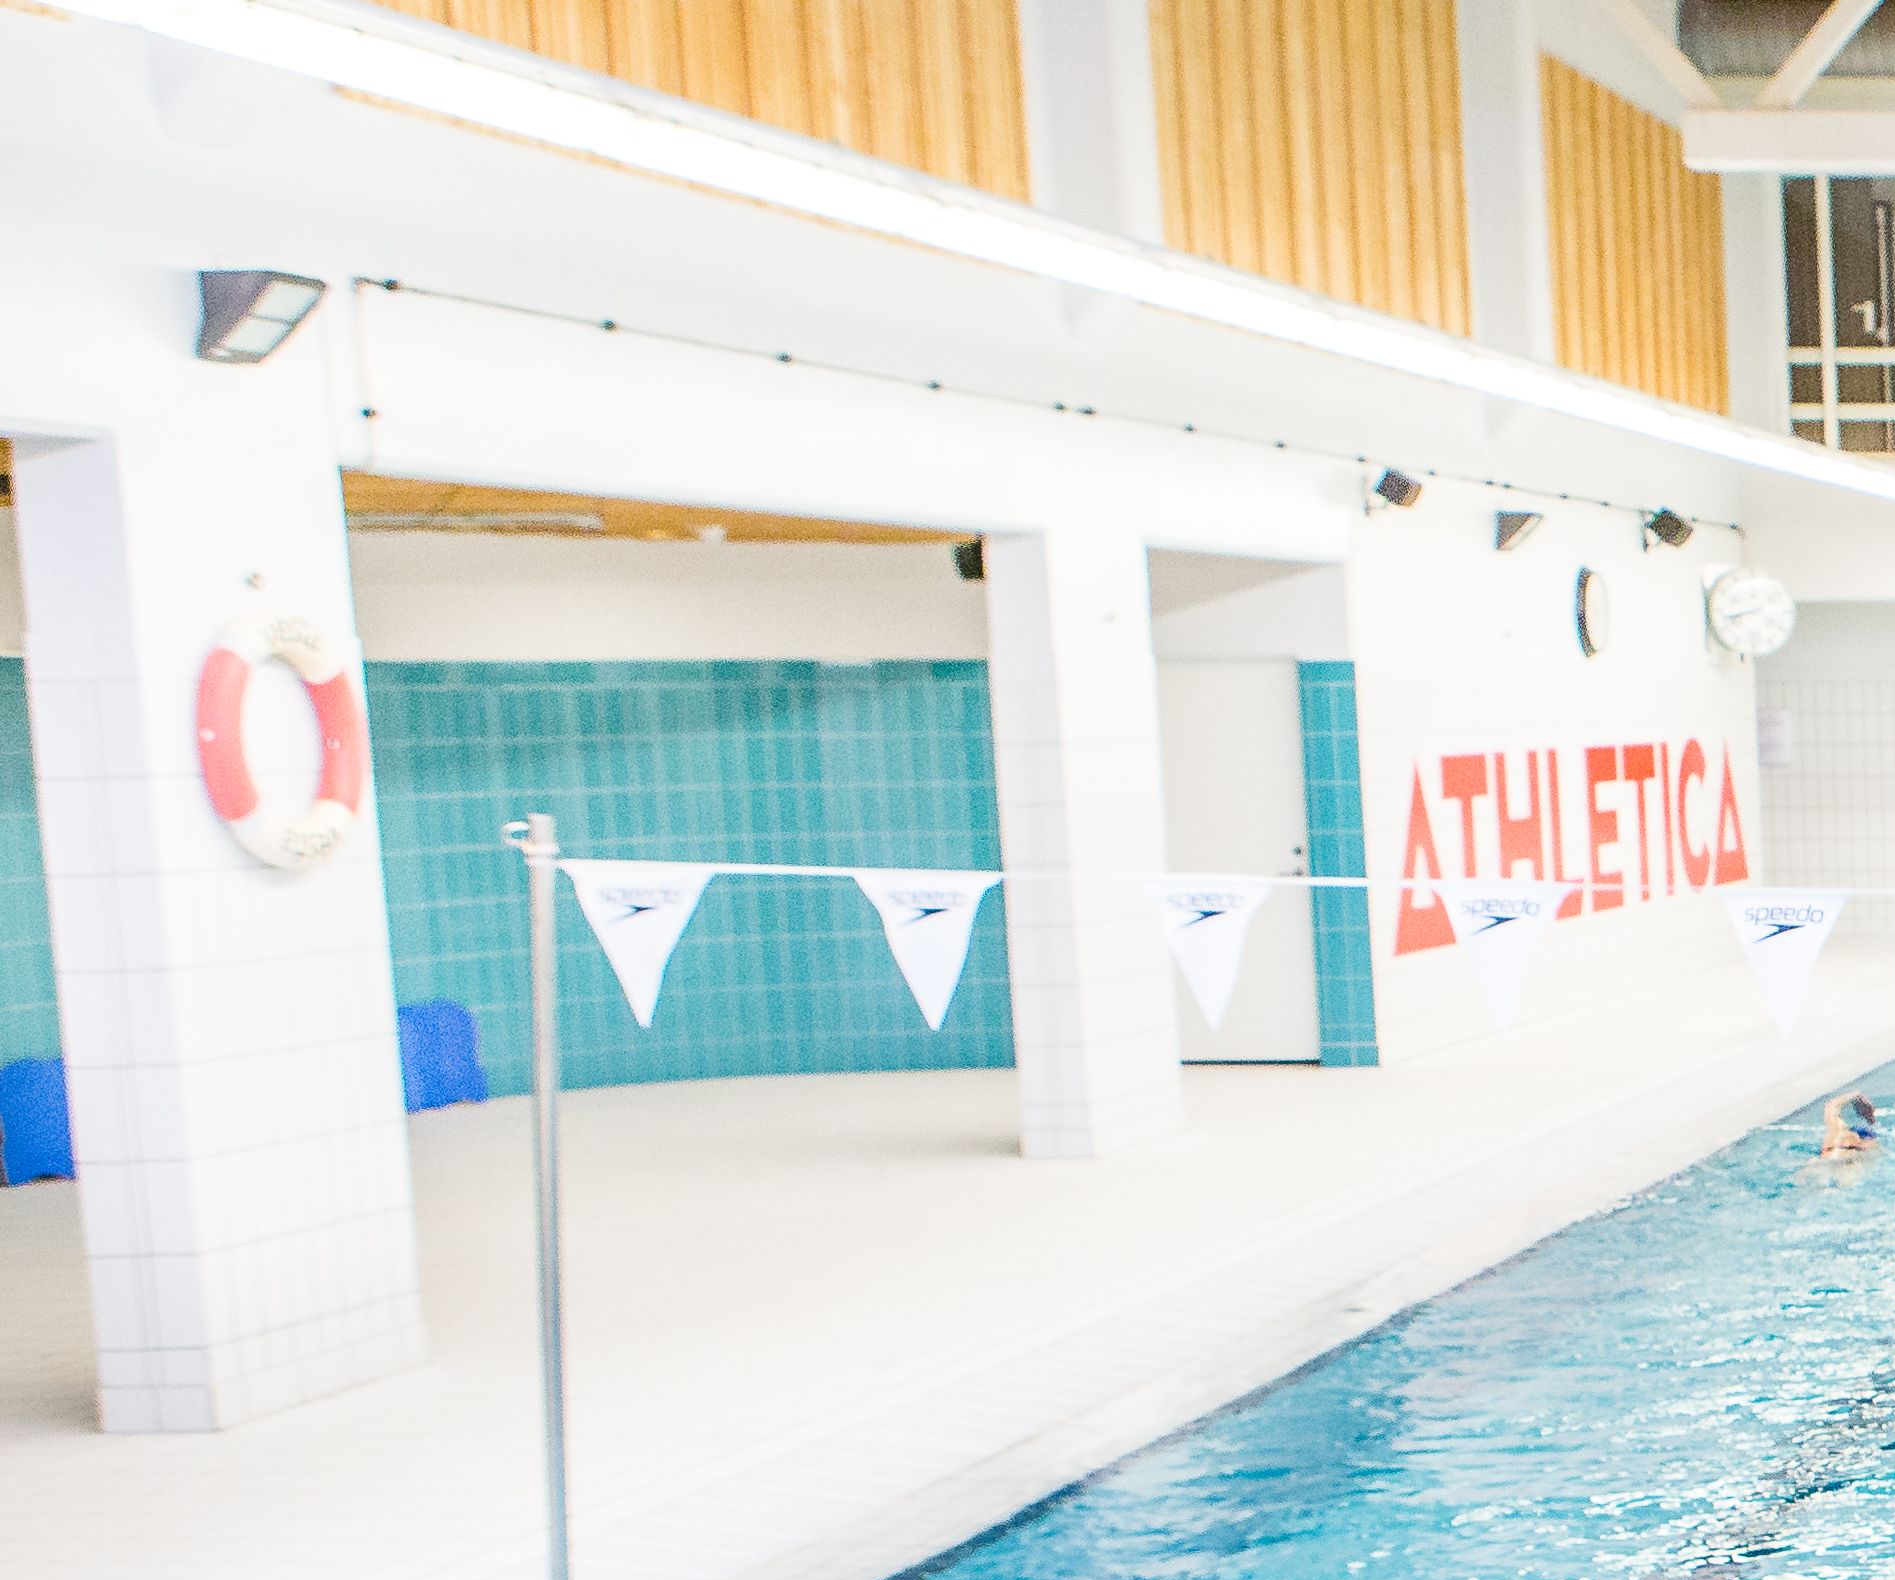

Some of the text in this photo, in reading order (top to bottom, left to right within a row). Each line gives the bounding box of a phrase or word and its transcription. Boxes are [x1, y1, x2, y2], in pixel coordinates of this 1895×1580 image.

[1394, 736, 1749, 956] ATHLETICA
[1461, 896, 1540, 918] speedo
[1744, 905, 1824, 925] speedo
